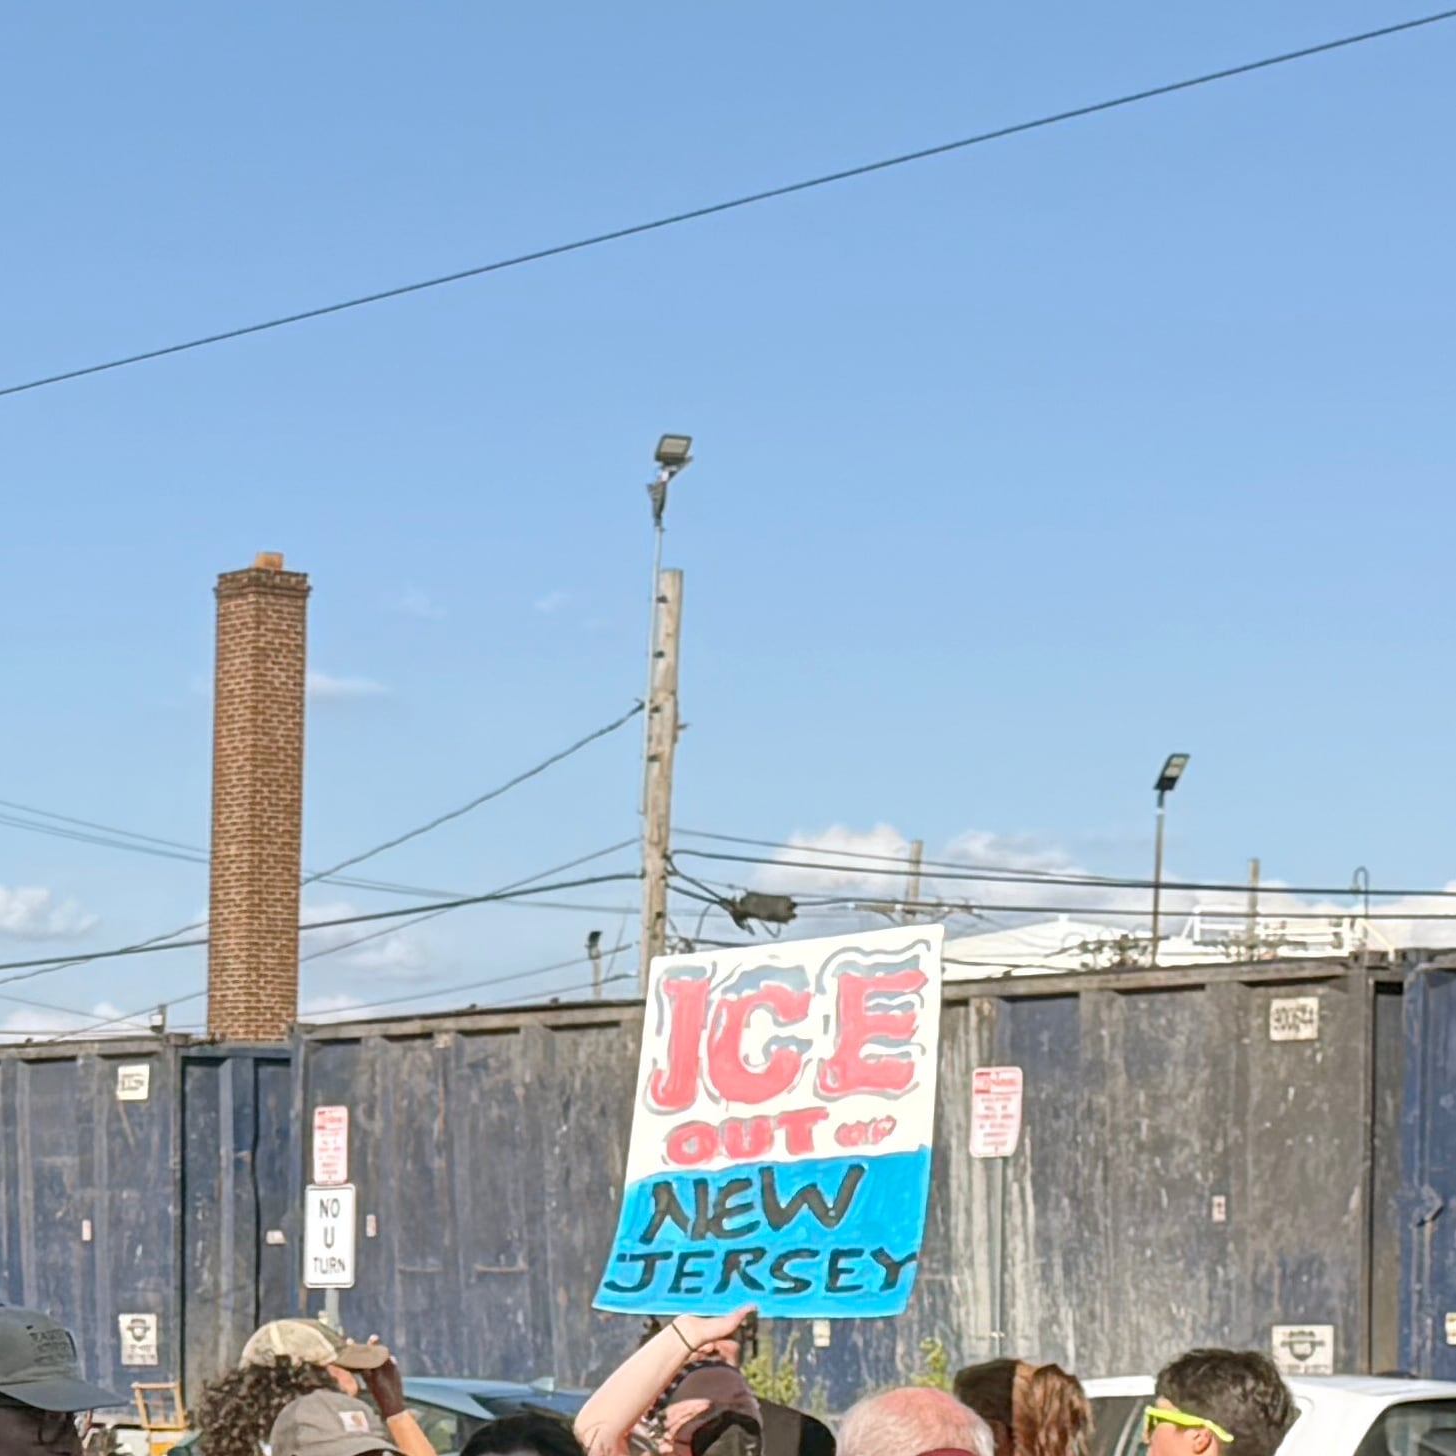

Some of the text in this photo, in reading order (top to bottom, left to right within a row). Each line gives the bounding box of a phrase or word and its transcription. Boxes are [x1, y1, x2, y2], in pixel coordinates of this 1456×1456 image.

[648, 950, 929, 1110] ICE
[665, 1106, 829, 1165] OUT
[319, 1198, 341, 1219] NO
[640, 1163, 866, 1244] NEW
[323, 1227, 335, 1248] U
[313, 1256, 346, 1275] TURN
[603, 1246, 918, 1294] JERSEY
